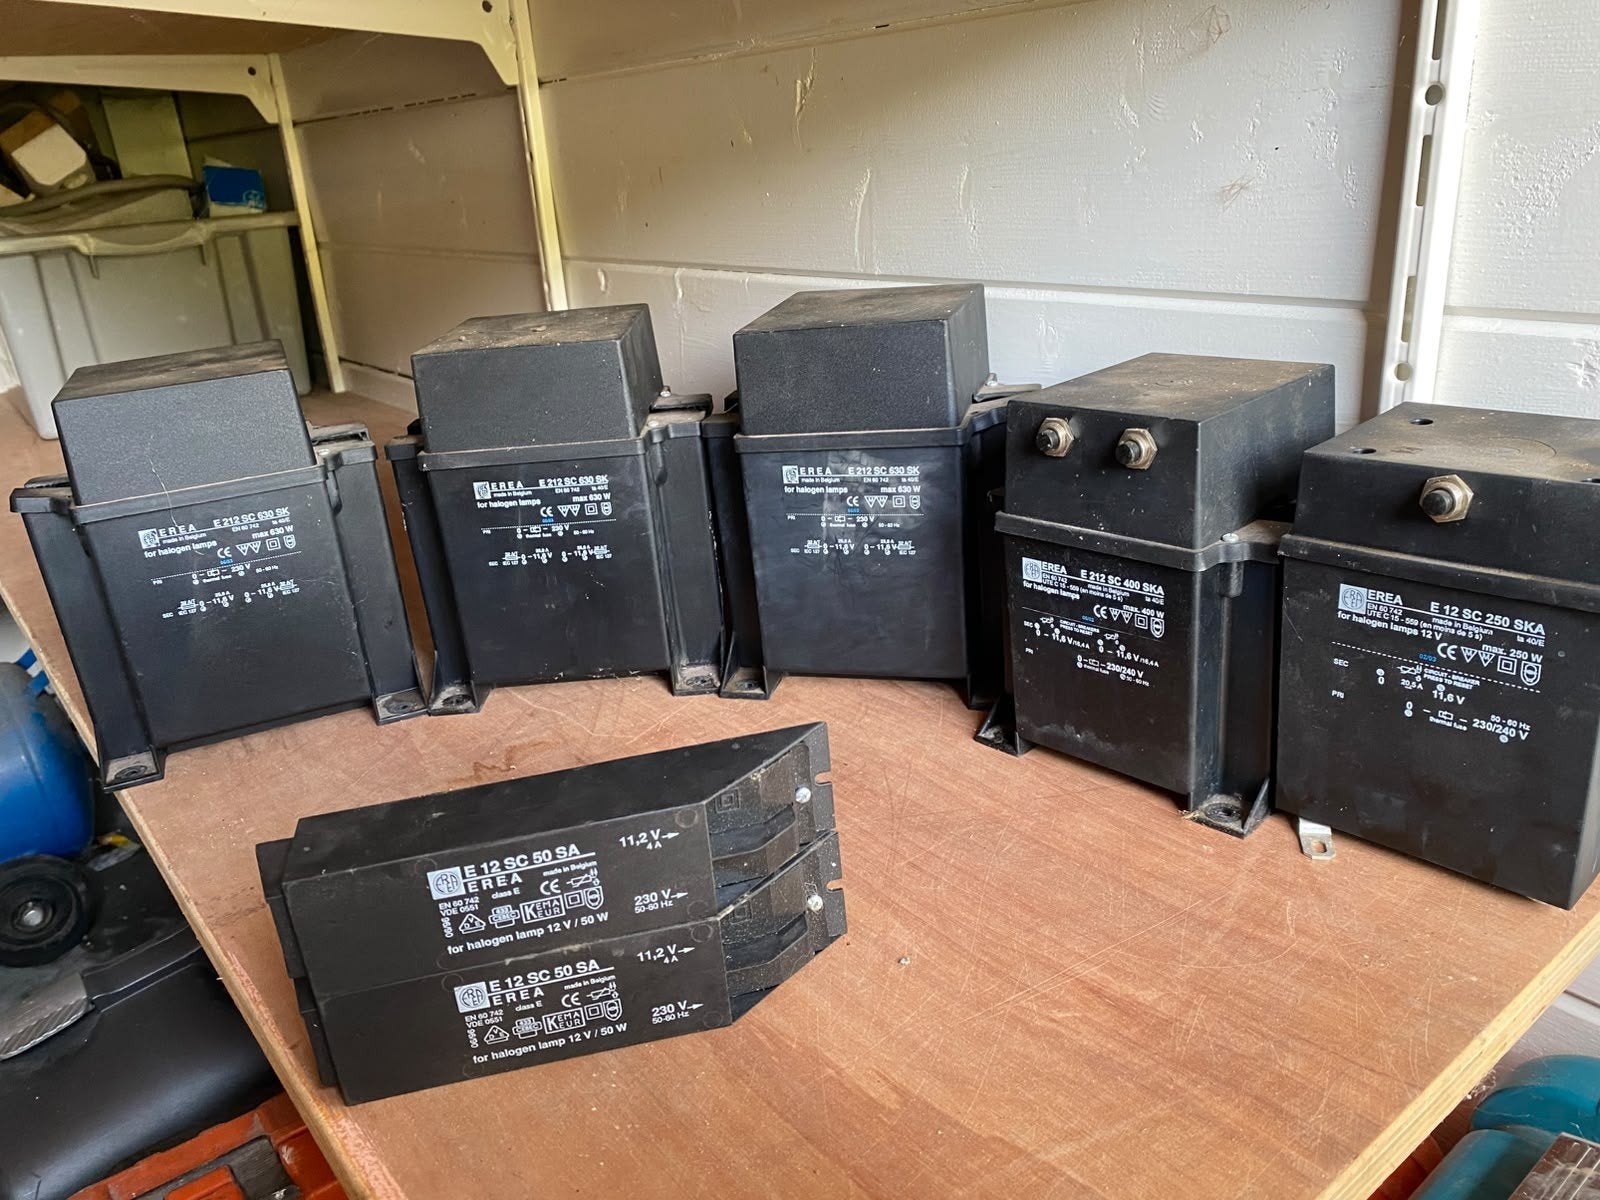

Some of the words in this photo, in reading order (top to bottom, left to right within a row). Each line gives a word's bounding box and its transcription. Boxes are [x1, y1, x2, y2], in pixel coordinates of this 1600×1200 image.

[800, 467, 832, 475] EREA
[856, 466, 872, 475] 212
[873, 466, 888, 475] SC
[888, 466, 905, 475] 630
[906, 466, 920, 474] SK
[490, 480, 524, 490] EREA
[539, 479, 546, 487] E
[547, 478, 564, 487] 212
[564, 476, 578, 485] SC
[579, 475, 594, 484] 630
[595, 474, 609, 483] SK
[796, 486, 824, 495] halogen
[826, 486, 848, 494] lamps
[489, 500, 518, 509] halogen
[519, 498, 541, 507] lamps
[213, 519, 222, 528] E
[222, 516, 240, 526] 212
[240, 512, 256, 523] SC
[256, 510, 274, 520] 630
[276, 507, 291, 517] SK
[158, 523, 197, 537] EREA
[252, 531, 269, 539] max
[270, 527, 284, 536] 630
[285, 525, 294, 533] W
[144, 550, 157, 558] for
[158, 544, 191, 556] halogen
[192, 540, 218, 550] lamps
[1042, 561, 1068, 574] EREA
[1080, 569, 1088, 578] E
[1089, 572, 1106, 582] 212
[1107, 575, 1121, 585] SC
[1123, 579, 1140, 590] 400
[1142, 583, 1165, 595] SKA
[1023, 580, 1032, 588] for
[1034, 583, 1059, 594] halogen
[1060, 589, 1080, 600] lamps
[1367, 589, 1403, 605] EREA
[1142, 608, 1155, 616] 400
[1156, 610, 1164, 619] W
[1366, 610, 1381, 618] UTE
[1390, 607, 1403, 616] 742
[1430, 601, 1440, 613] E
[1443, 604, 1459, 617] 12
[1462, 608, 1482, 621] SC
[1485, 614, 1510, 627] 250
[1513, 619, 1546, 635] SKA
[1337, 610, 1351, 620] for
[1352, 613, 1388, 629] halogen
[1390, 622, 1418, 636] lamps
[1421, 629, 1432, 639] 12
[1434, 632, 1442, 640] V
[1432, 618, 1452, 627] made
[1462, 623, 1493, 635] Belgium
[1526, 637, 1545, 647] 40/E
[1482, 644, 1506, 655] max.
[1509, 649, 1528, 660] 250
[1530, 653, 1543, 663] W
[1333, 658, 1349, 668] SEC
[1331, 690, 1345, 699] PRI
[1432, 689, 1455, 702] 11,6
[1456, 695, 1465, 705] V
[1472, 718, 1516, 737] 230/240
[1519, 731, 1529, 741] V
[1490, 714, 1501, 723] 50
[1519, 721, 1531, 730] Hz
[619, 832, 648, 847] 11,2
[650, 828, 660, 840] V
[464, 865, 477, 878] E
[480, 860, 501, 874] 12
[504, 855, 528, 869] SC
[533, 849, 552, 863] 50
[555, 844, 580, 858] SA
[543, 868, 562, 876] made
[570, 861, 597, 870] Belgium
[467, 873, 523, 892] EREA
[464, 896, 479, 904] 742
[491, 890, 512, 899] class
[634, 892, 658, 906] 230
[661, 888, 671, 899] V
[440, 908, 458, 916] VDE
[460, 904, 479, 913] 0551
[537, 907, 560, 918] EUR
[634, 903, 659, 914] 50-60
[447, 945, 464, 955] for
[466, 934, 514, 950] halogen
[516, 927, 544, 940] lamp
[547, 923, 561, 933] 12
[563, 920, 571, 929] V
[580, 915, 594, 926] 50
[596, 912, 608, 922] W
[637, 948, 665, 962] 11,2
[667, 944, 676, 954] V
[489, 980, 501, 992] E
[505, 976, 524, 988] 12
[527, 970, 550, 984] SC
[554, 965, 572, 978] 50
[576, 959, 600, 973] SA
[564, 981, 582, 990] made
[590, 975, 616, 984] Belgium
[492, 987, 544, 1006] EREA
[515, 1003, 535, 1011] class
[652, 1004, 675, 1017] 230
[677, 1000, 688, 1010] V
[560, 1018, 580, 1029] EUR
[652, 1014, 675, 1024] 50-60
[473, 1055, 488, 1064] for
[491, 1044, 536, 1059] halogen
[538, 1038, 566, 1049] lamp
[569, 1033, 582, 1043] 12
[584, 1030, 591, 1039] V
[600, 1026, 614, 1036] 50
[615, 1022, 627, 1032] W
